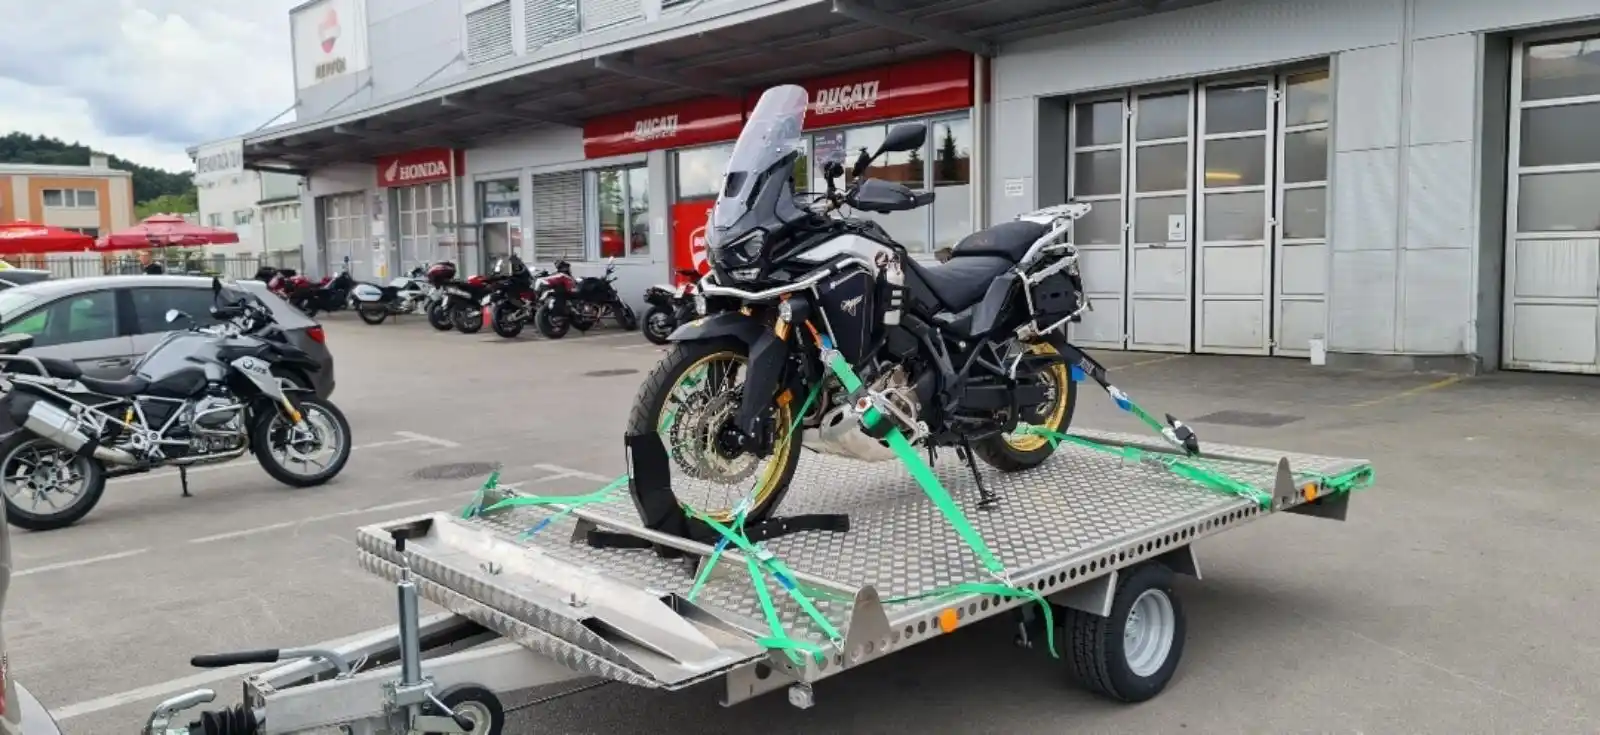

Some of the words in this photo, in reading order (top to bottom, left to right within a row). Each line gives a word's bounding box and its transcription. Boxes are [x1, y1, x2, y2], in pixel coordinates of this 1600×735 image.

[816, 81, 880, 106] DUCATI
[815, 101, 877, 115] SERVICE
[635, 114, 679, 136] DUCATI
[399, 160, 448, 181] HONDA
